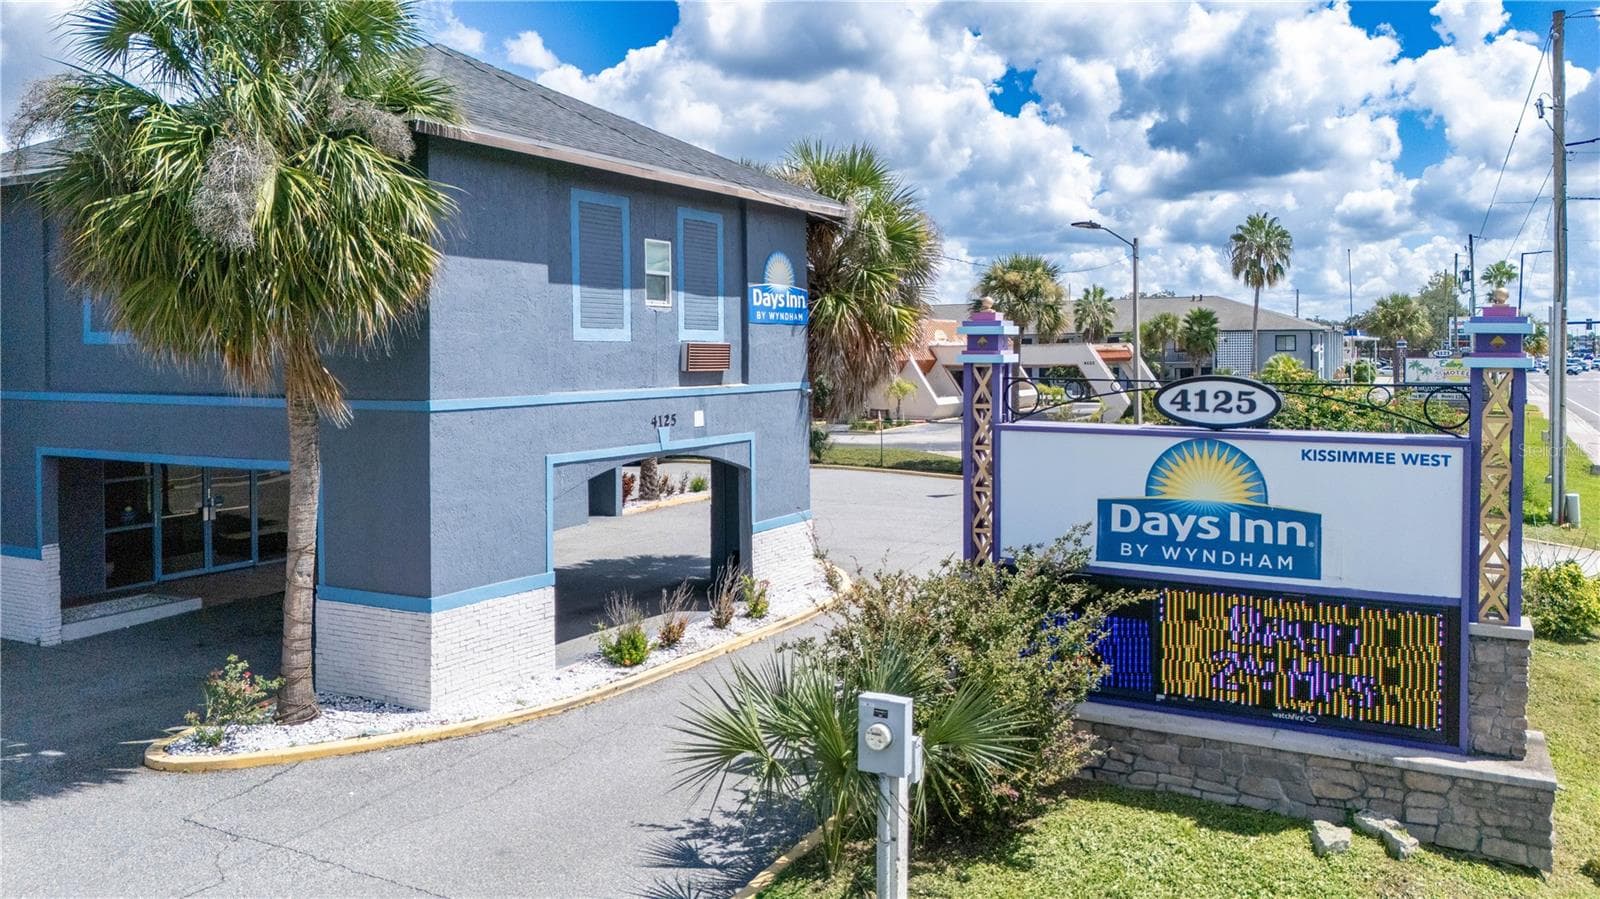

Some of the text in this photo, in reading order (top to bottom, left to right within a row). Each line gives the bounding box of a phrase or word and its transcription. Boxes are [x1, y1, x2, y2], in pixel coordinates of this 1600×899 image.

[752, 288, 806, 310] Days Inn
[756, 311, 803, 321] BY WYNDHAM
[1169, 389, 1257, 415] 4125
[650, 413, 677, 430] 4125
[1301, 449, 1452, 467] KISSIMMEE WEST
[1111, 503, 1307, 547] Days Inn
[1120, 542, 1293, 571] BY WYNDHAM
